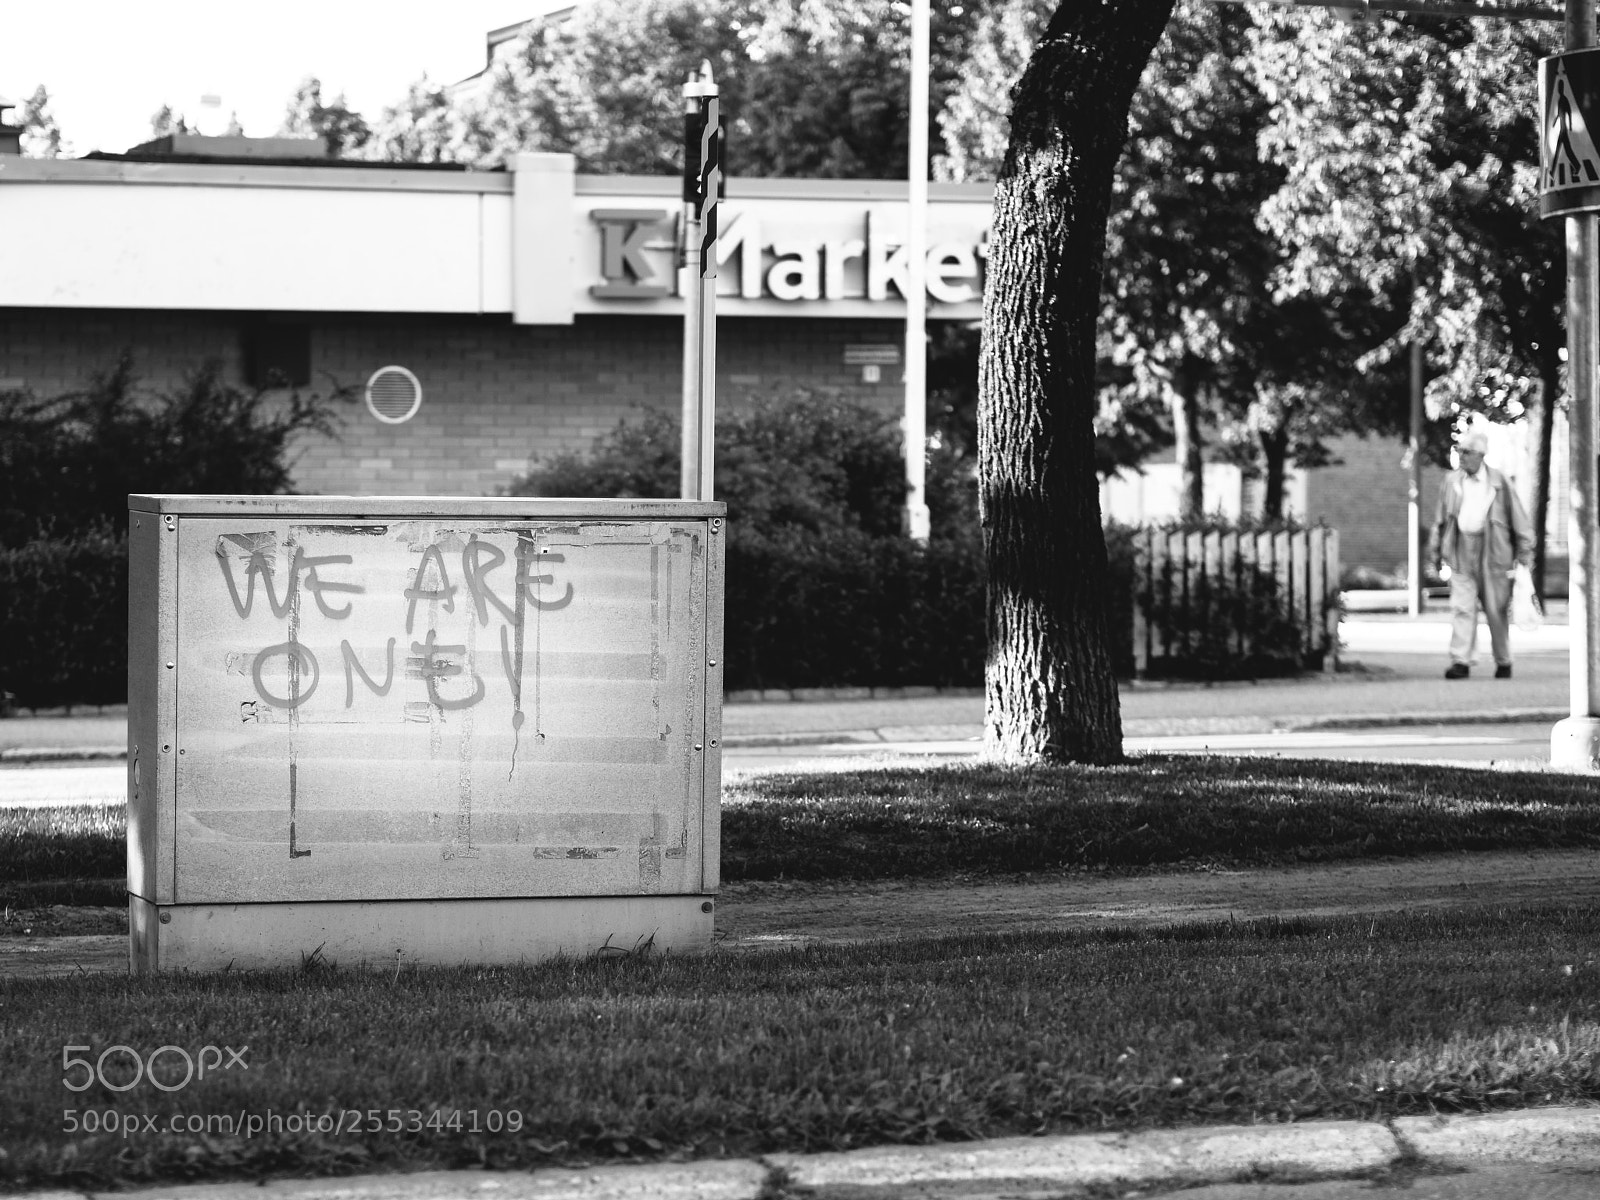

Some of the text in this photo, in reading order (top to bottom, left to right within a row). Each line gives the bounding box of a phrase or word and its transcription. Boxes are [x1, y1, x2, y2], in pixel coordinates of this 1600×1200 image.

[674, 209, 991, 303] Marke
[215, 533, 574, 634] WE ARE
